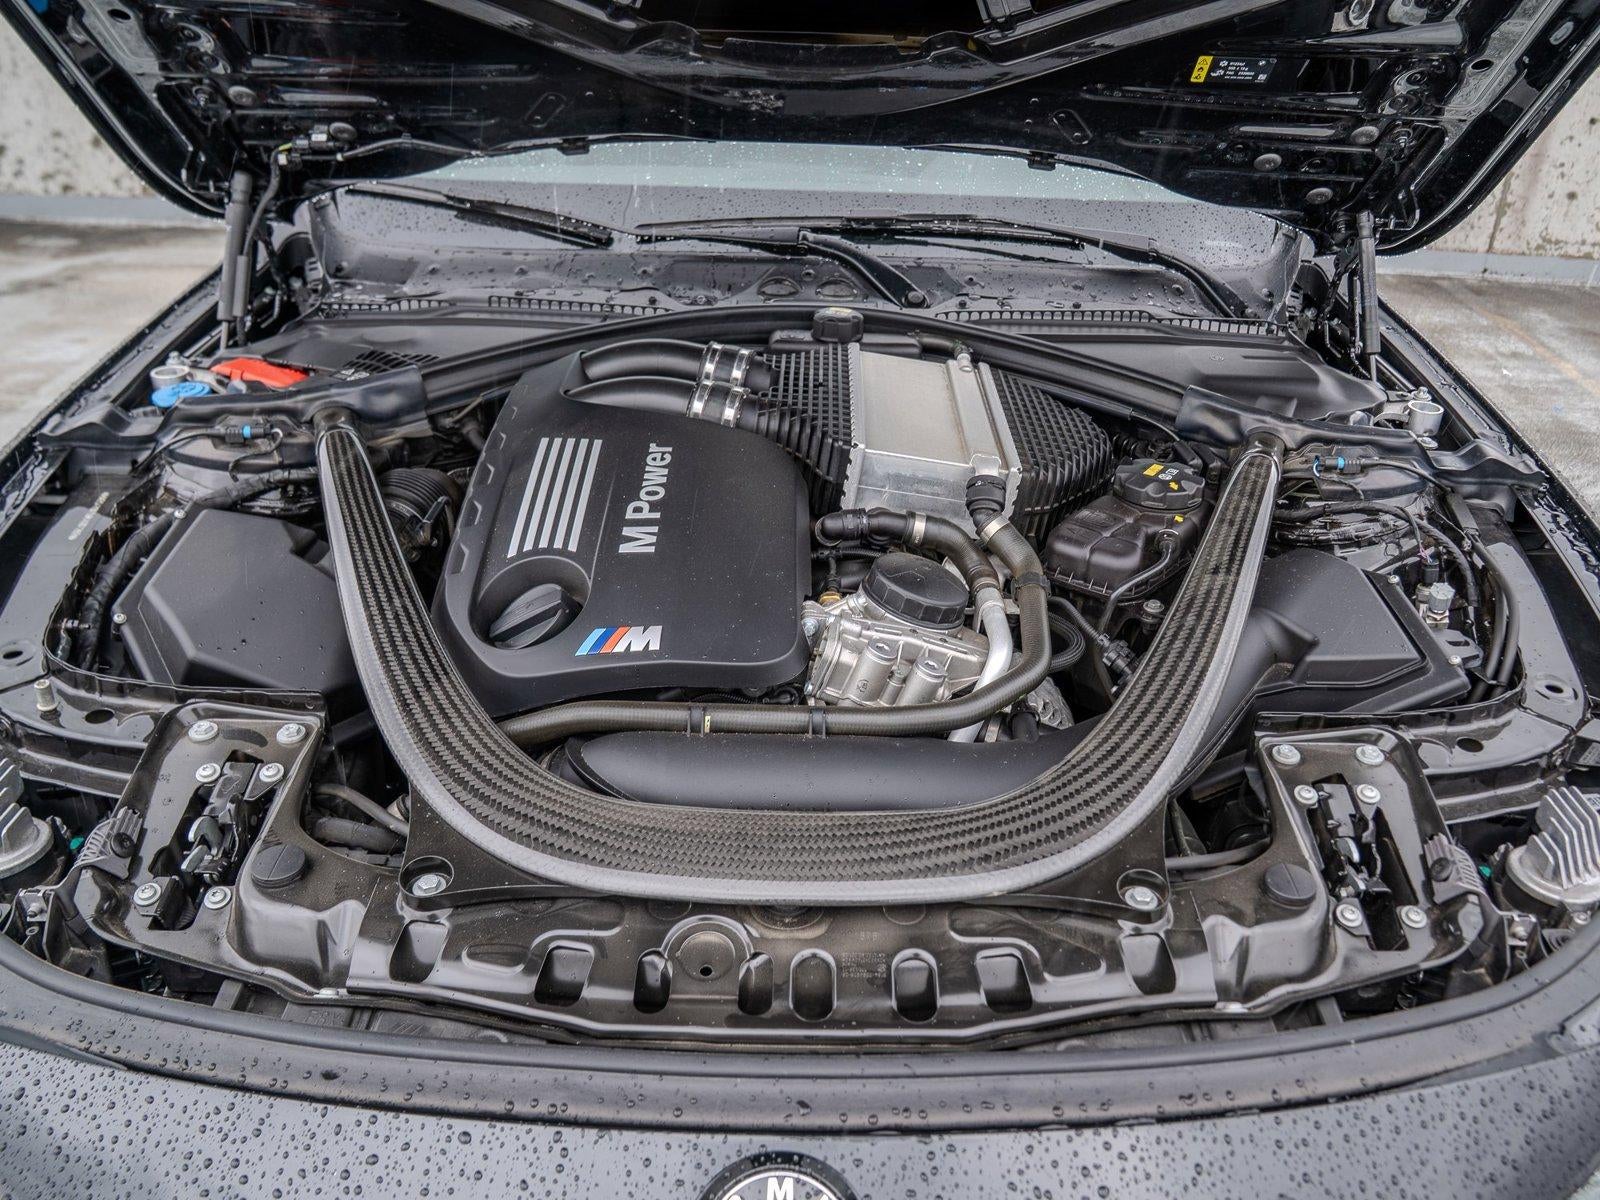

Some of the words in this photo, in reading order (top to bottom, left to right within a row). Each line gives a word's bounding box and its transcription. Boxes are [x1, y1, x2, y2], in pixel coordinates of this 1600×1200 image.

[625, 443, 673, 519] Power
[618, 526, 659, 553] M
[612, 626, 663, 651] M
